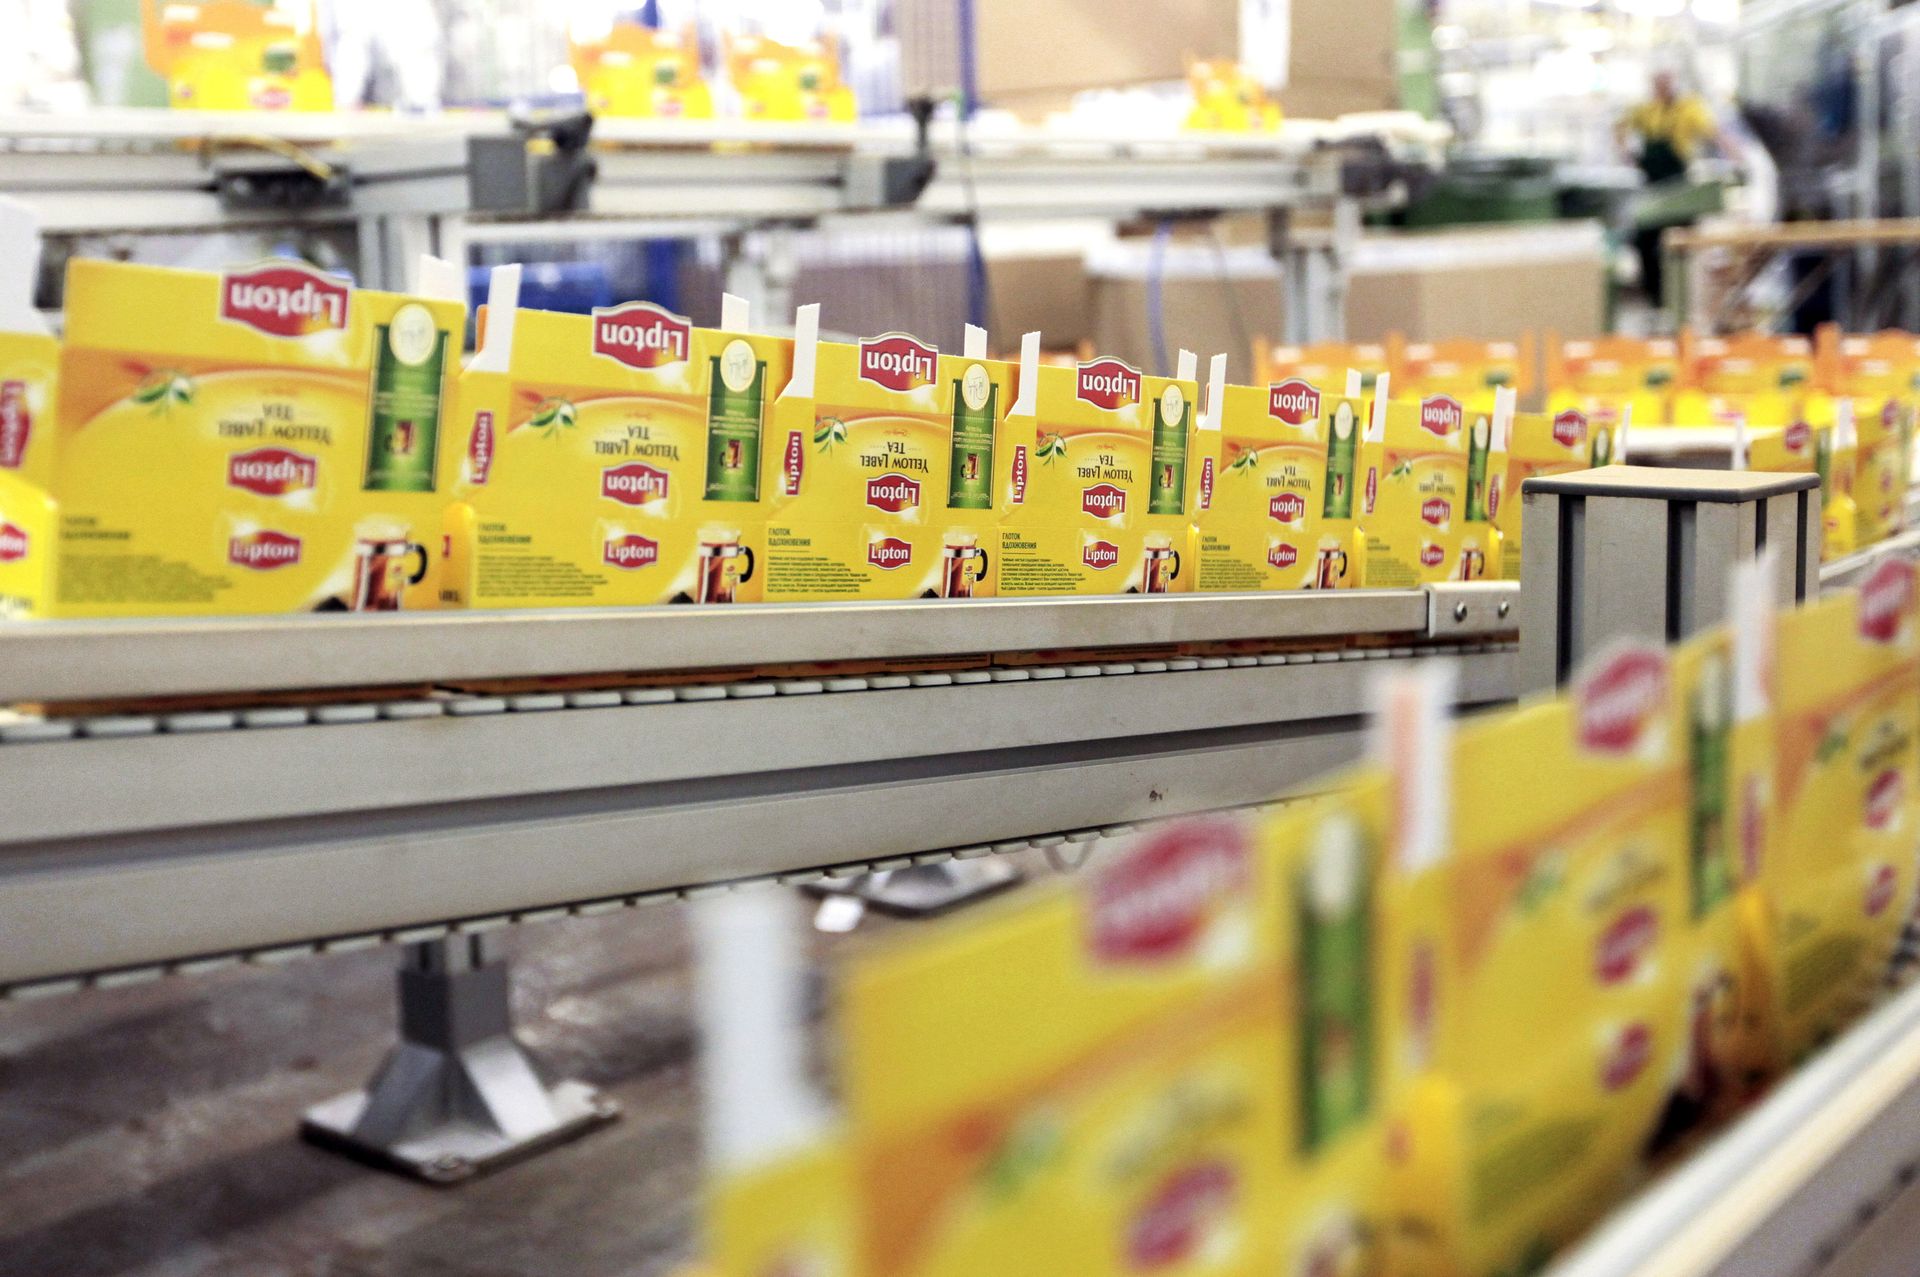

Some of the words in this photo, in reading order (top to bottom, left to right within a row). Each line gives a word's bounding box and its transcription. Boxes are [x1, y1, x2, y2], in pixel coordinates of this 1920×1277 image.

[231, 281, 341, 325] Lipton
[601, 320, 683, 357] Lipton
[866, 348, 932, 381] Lipton
[1082, 372, 1137, 400] Lipton
[1273, 390, 1317, 418] Lipton
[627, 425, 650, 440] TEA
[471, 415, 488, 480] Lipton
[593, 439, 630, 456] LABEL
[633, 444, 680, 462] YELLOW
[886, 441, 905, 454] TEA
[788, 436, 800, 491] Lipton
[859, 453, 889, 468] LABEL
[892, 458, 929, 473] YELLOW
[1099, 454, 1114, 466] TEA
[1014, 449, 1025, 500] Lipton
[1076, 465, 1100, 478] LABEL
[1102, 469, 1134, 483] YELLOW
[606, 471, 665, 497] Lipton
[1202, 461, 1211, 506] Lipton
[870, 483, 917, 505] Lipton
[1085, 493, 1123, 512] Lipton
[1271, 497, 1303, 516] Lipton
[607, 543, 655, 563] Lipton
[870, 545, 908, 563] Lipton
[1085, 548, 1116, 564] Lipton
[1269, 549, 1296, 564] Lipton
